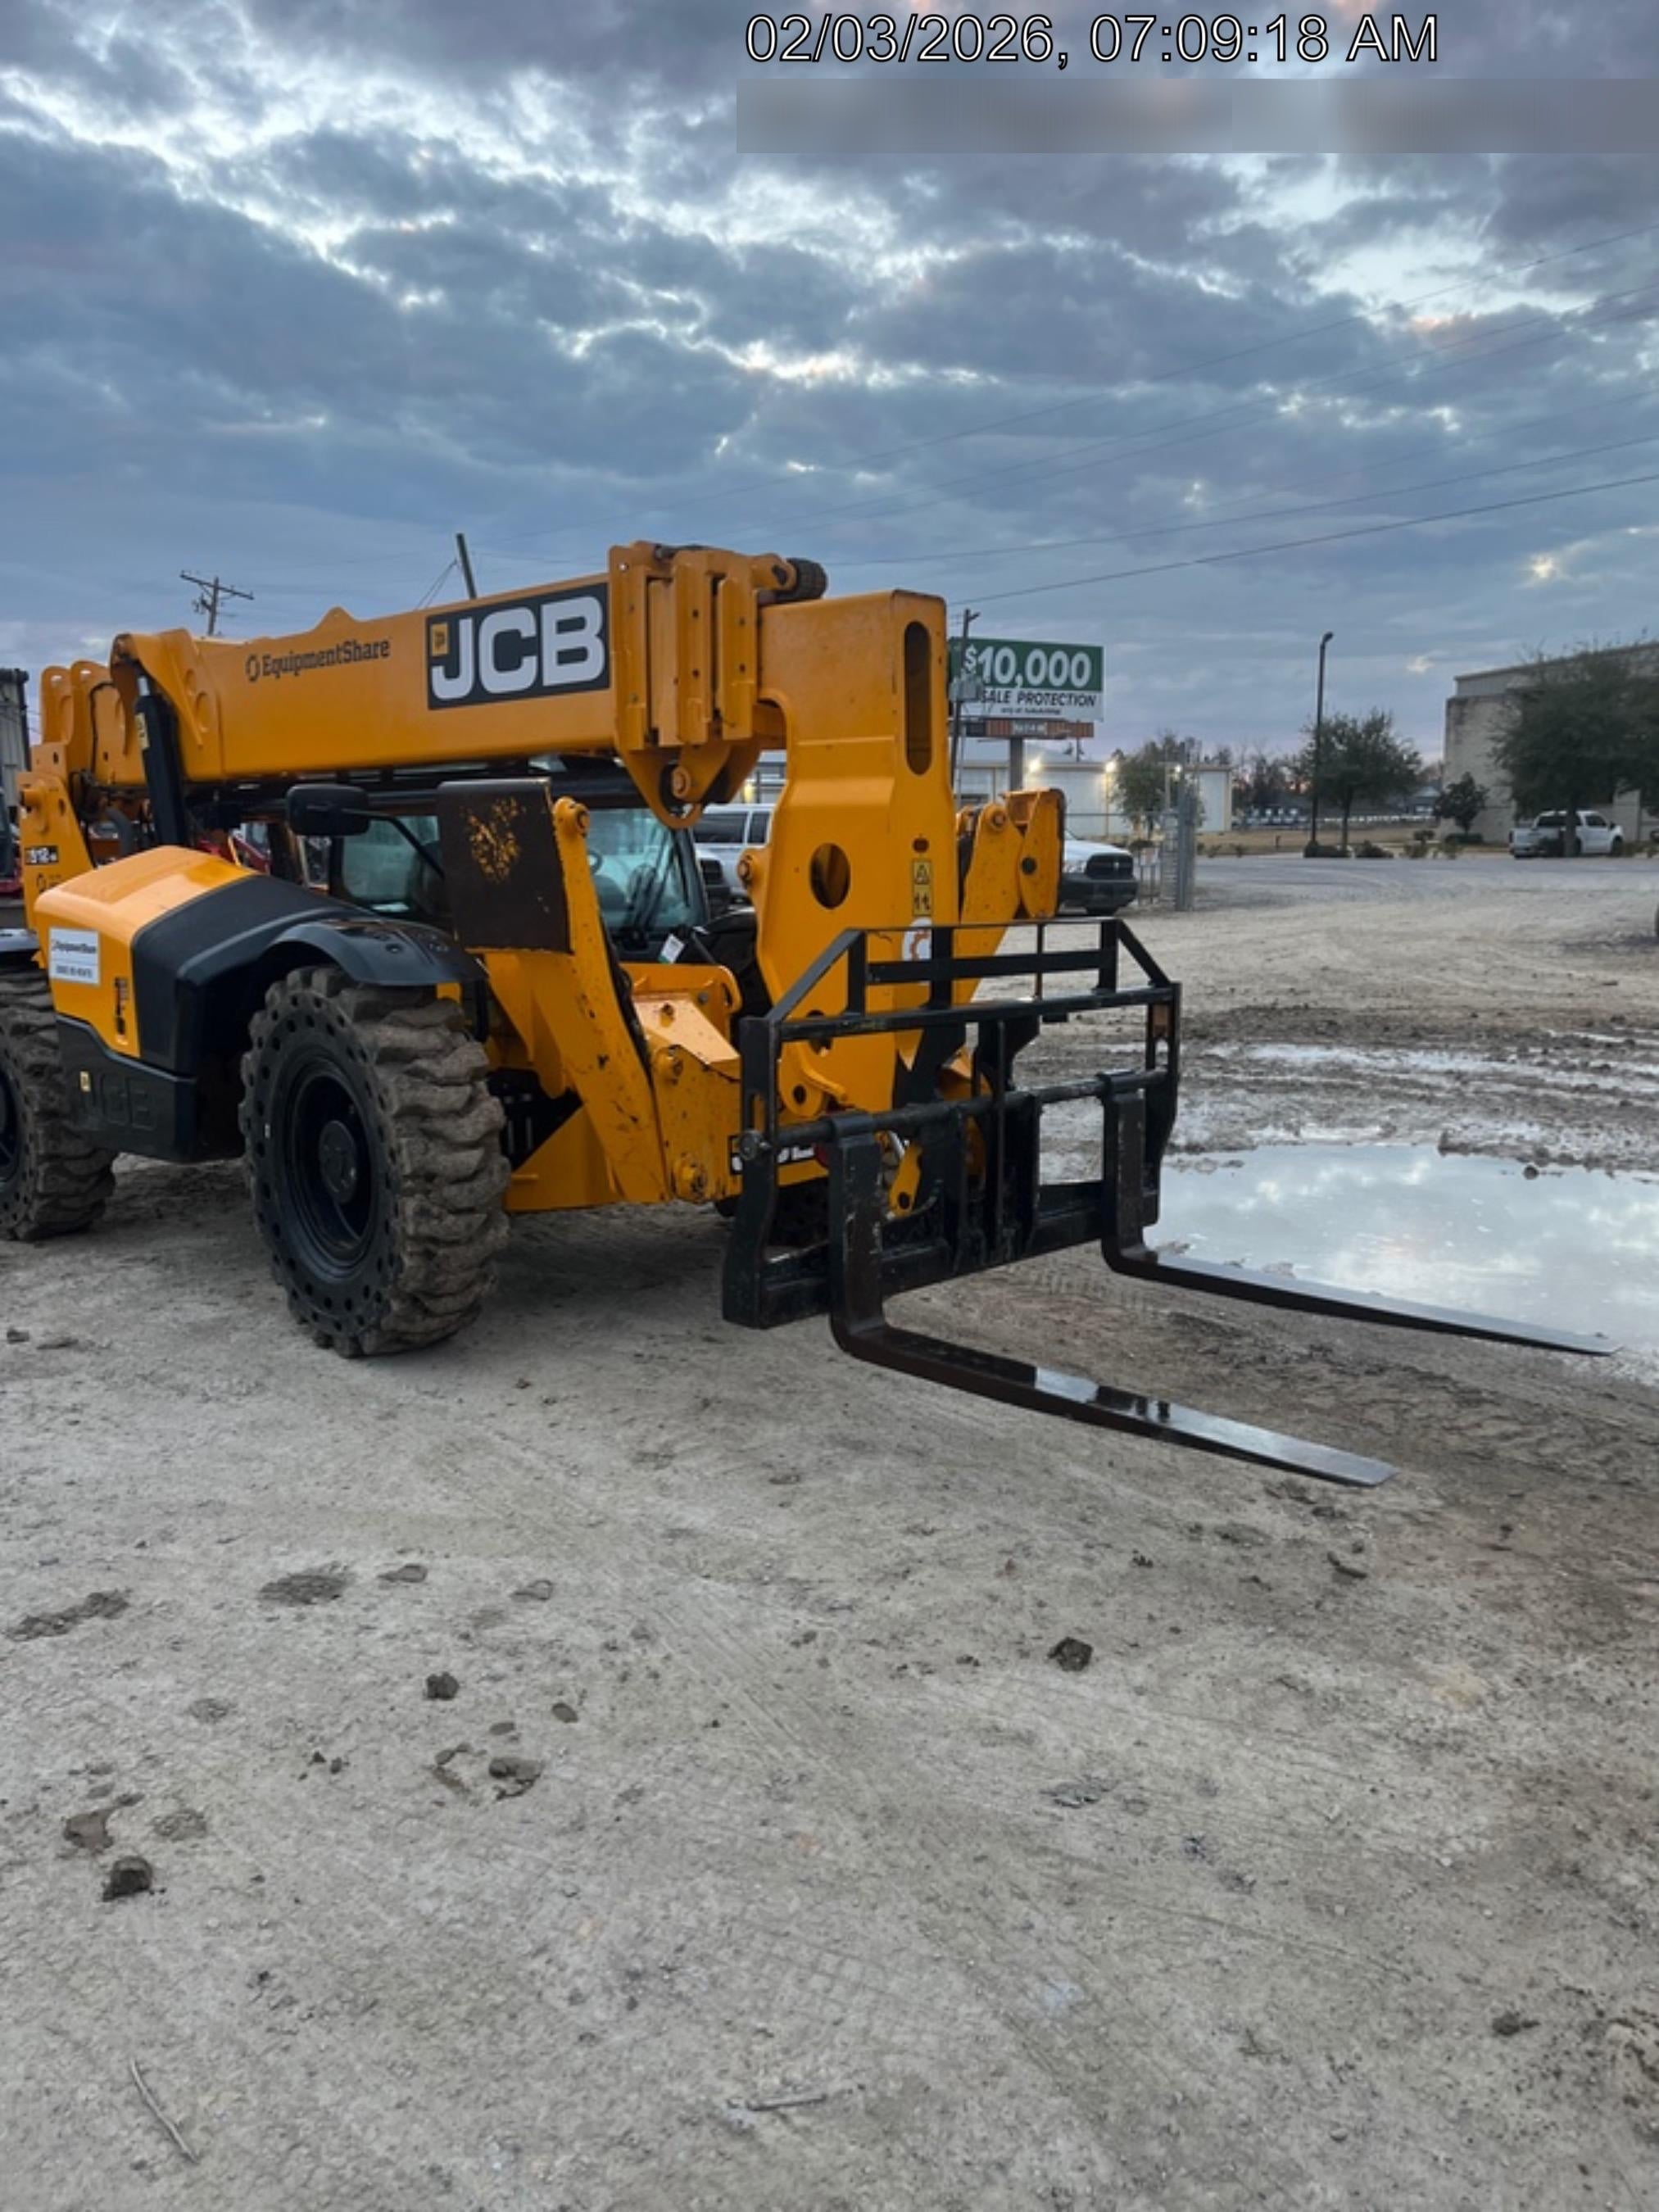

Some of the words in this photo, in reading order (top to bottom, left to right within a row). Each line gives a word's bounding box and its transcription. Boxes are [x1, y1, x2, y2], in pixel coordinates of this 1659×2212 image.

[261, 639, 391, 679] EquipmentShare
[431, 596, 605, 700] JCB
[964, 644, 1092, 688] $10,000
[1017, 691, 1097, 708] PROTECTION
